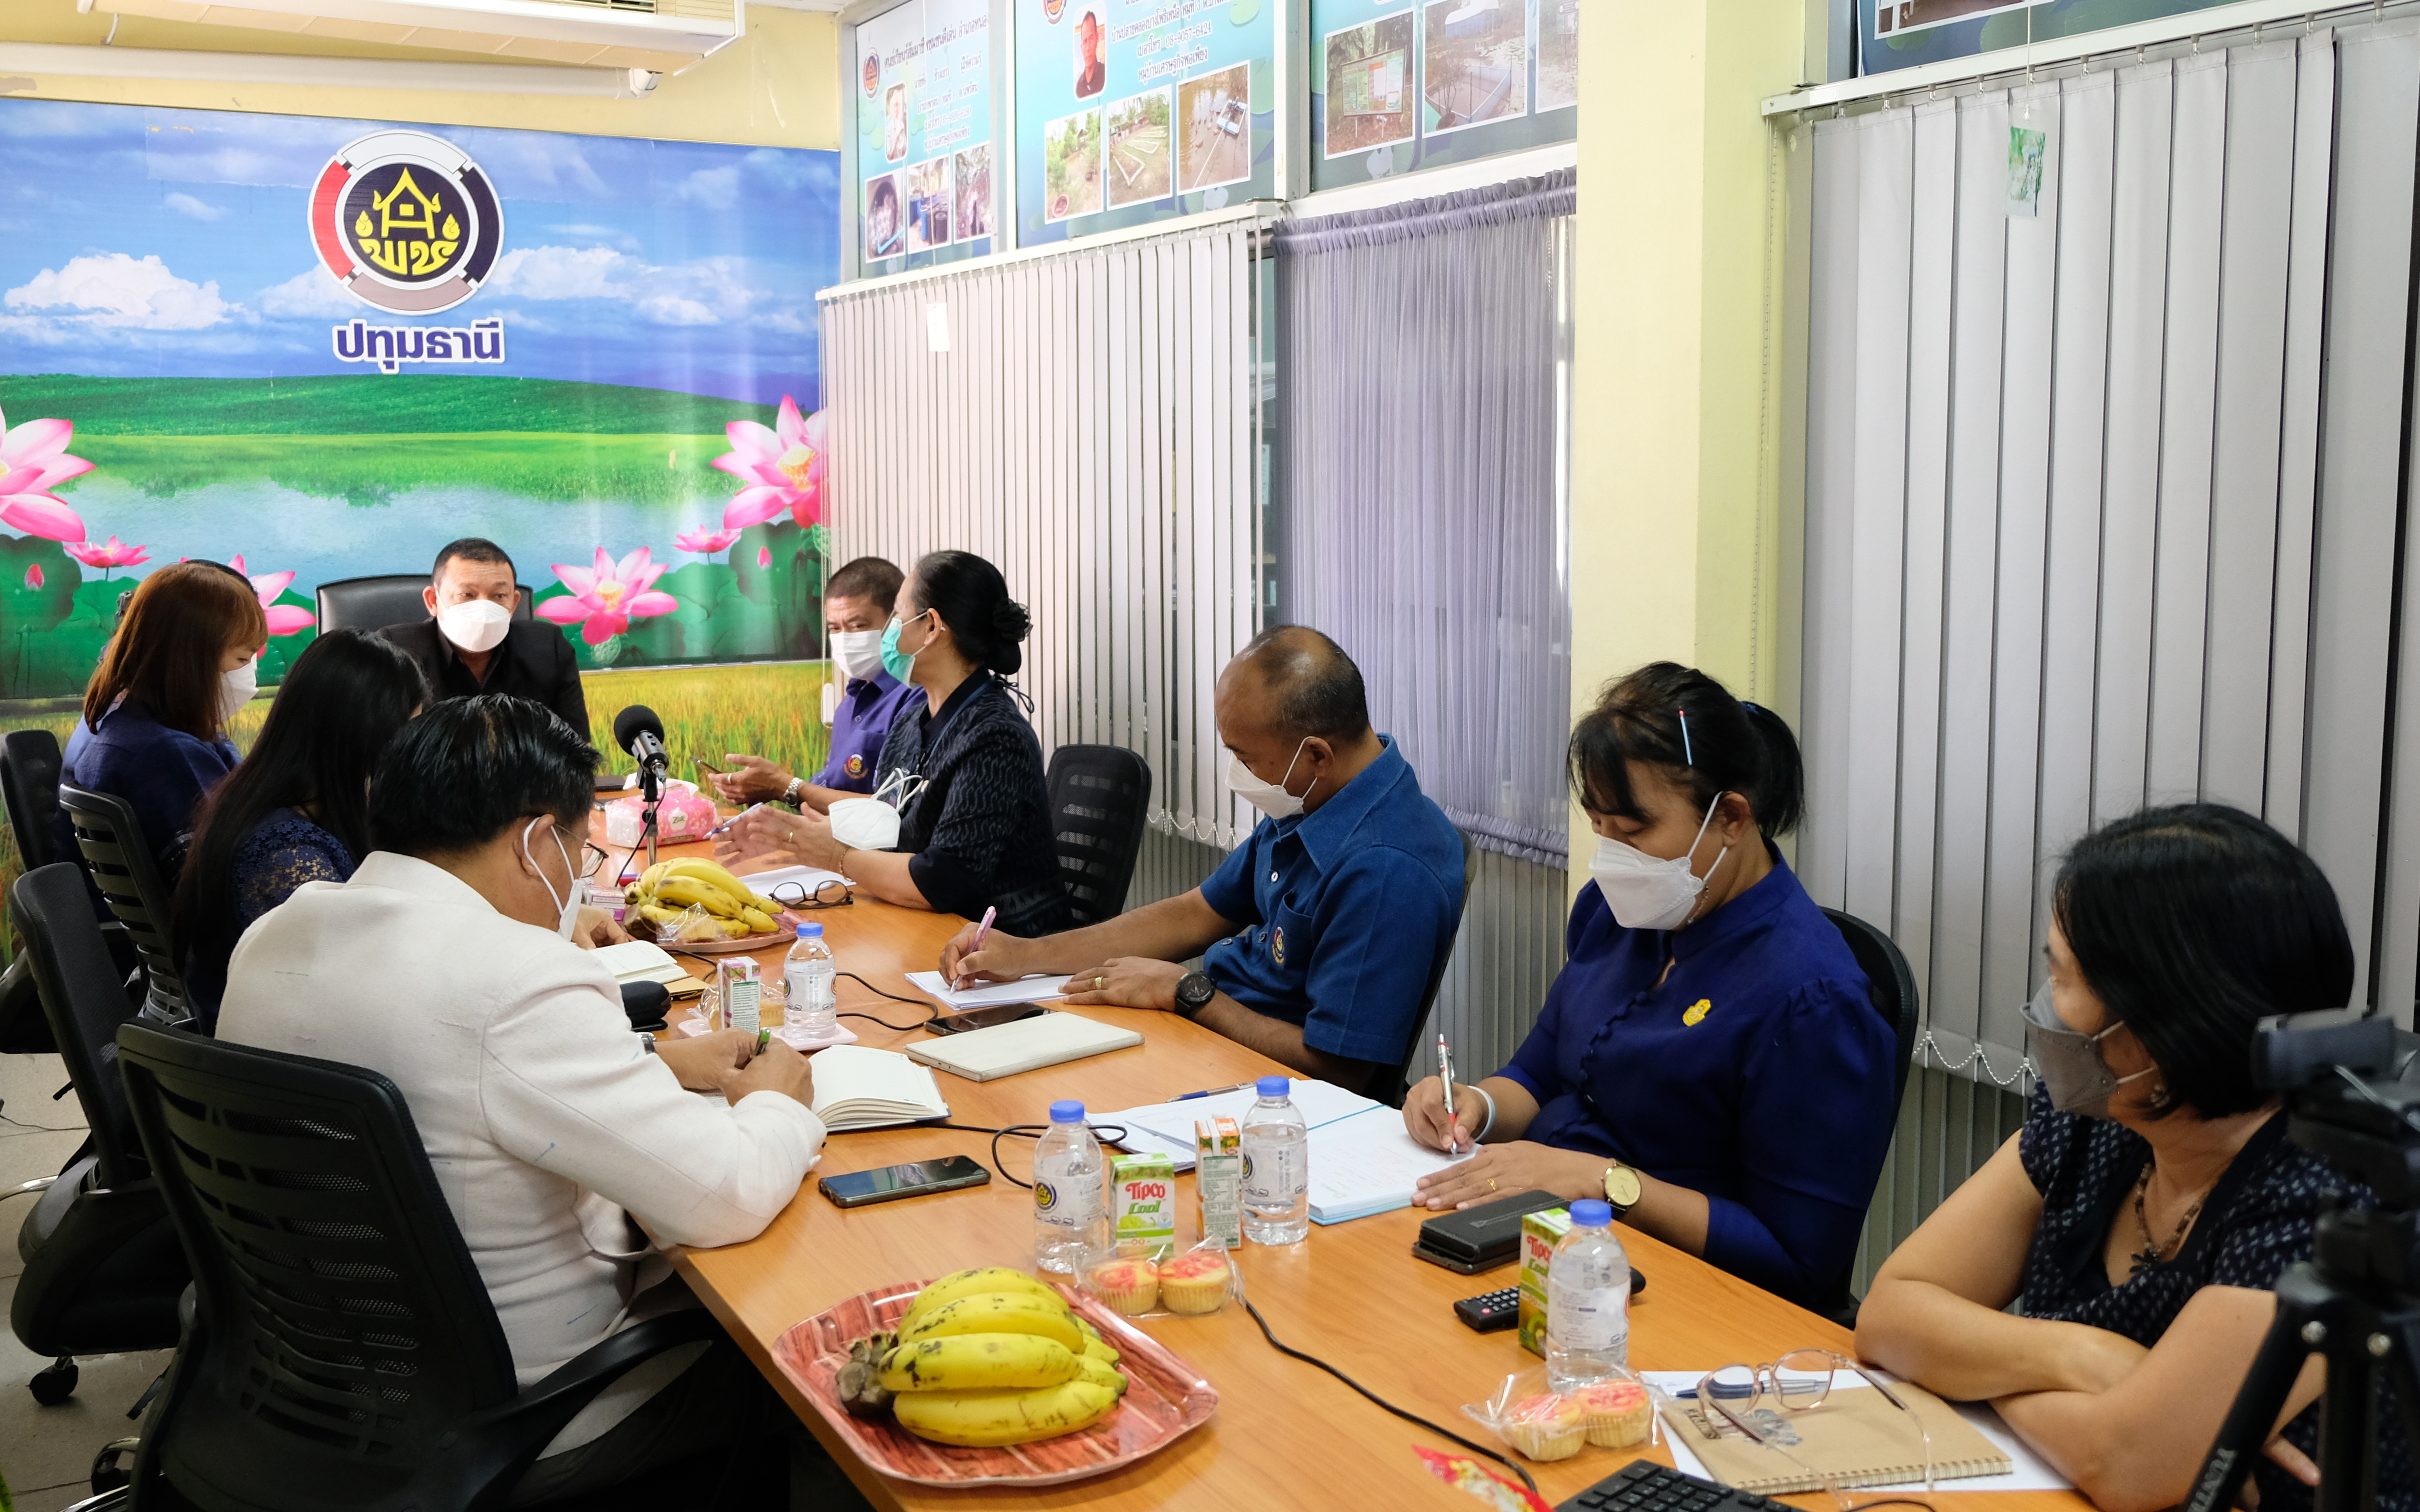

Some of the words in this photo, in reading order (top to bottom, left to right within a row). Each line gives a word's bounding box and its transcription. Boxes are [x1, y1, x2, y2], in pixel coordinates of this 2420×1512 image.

[1165, 22, 1211, 47] 08-9057-6424
[1138, 47, 1207, 83] หมู่บ้านเศรษฐกิจพอเพียง
[336, 321, 500, 370] ปทุมธานี
[1128, 1200, 1161, 1214] Cool
